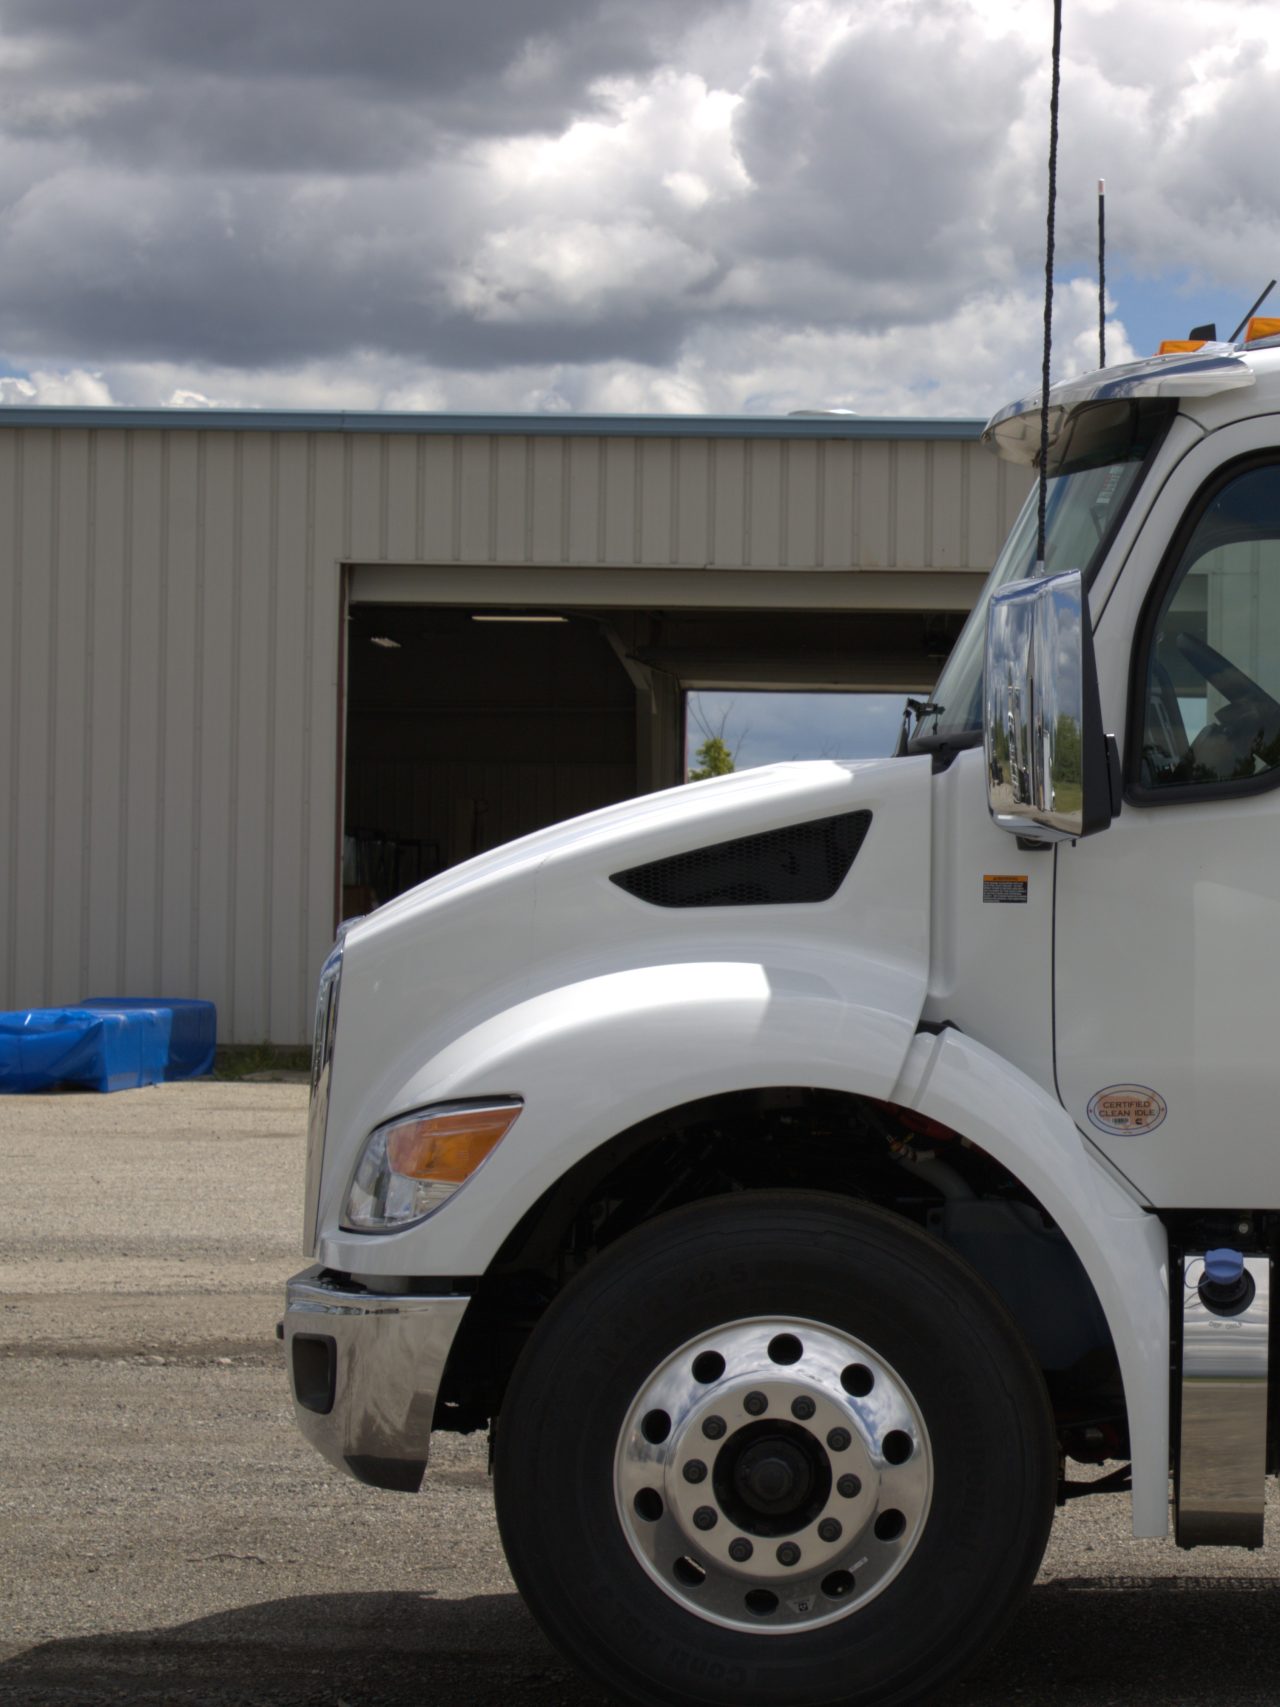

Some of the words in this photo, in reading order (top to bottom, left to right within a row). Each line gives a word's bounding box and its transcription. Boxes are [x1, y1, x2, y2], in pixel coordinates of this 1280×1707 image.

[1102, 1101, 1151, 1109] CERTIFIED
[1098, 1109, 1131, 1117] CLEAN
[1134, 1109, 1156, 1117] IDLE
